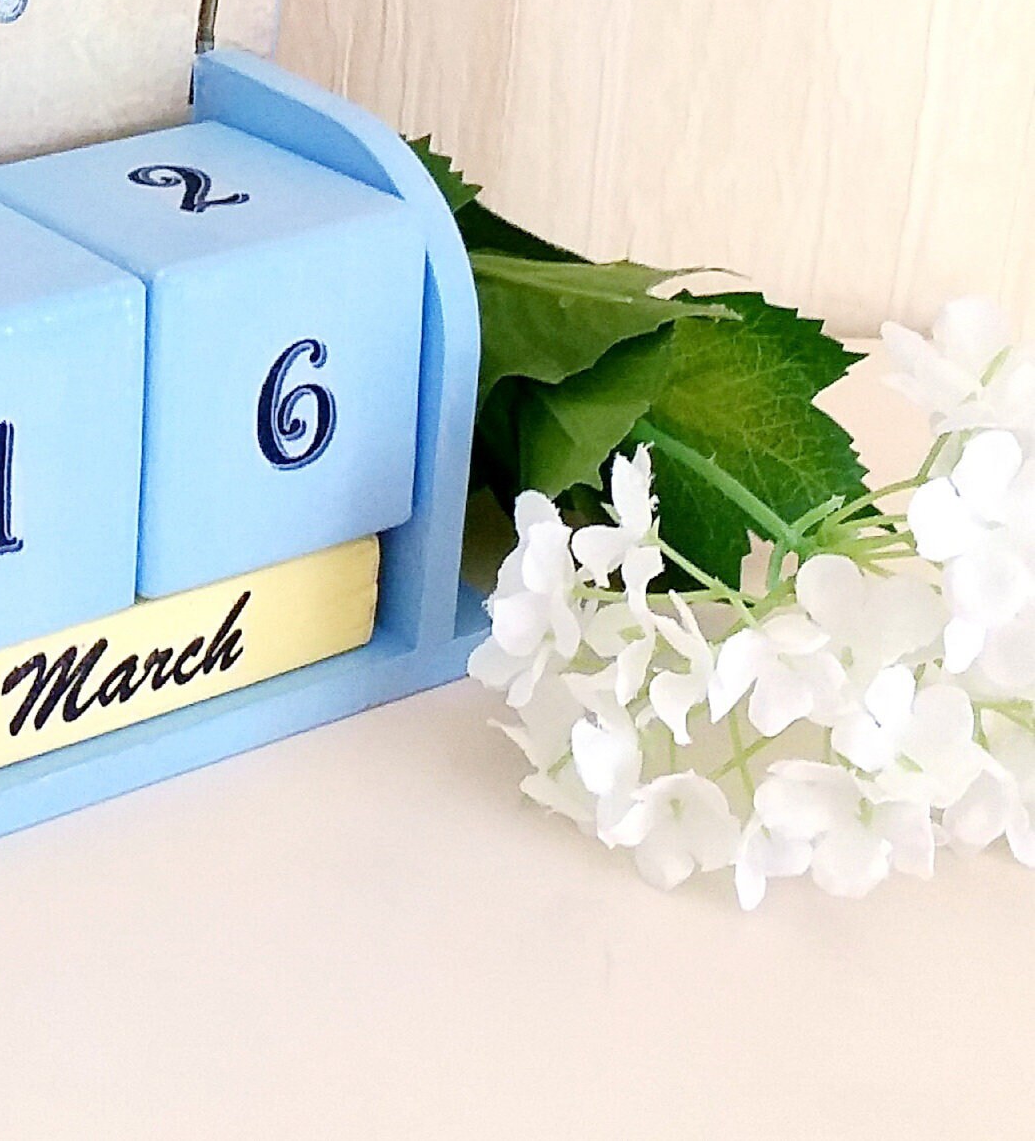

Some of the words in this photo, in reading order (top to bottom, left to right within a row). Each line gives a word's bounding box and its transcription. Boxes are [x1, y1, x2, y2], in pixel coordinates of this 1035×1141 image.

[127, 163, 251, 213] 2
[256, 338, 338, 471] 6
[0, 590, 252, 737] March
